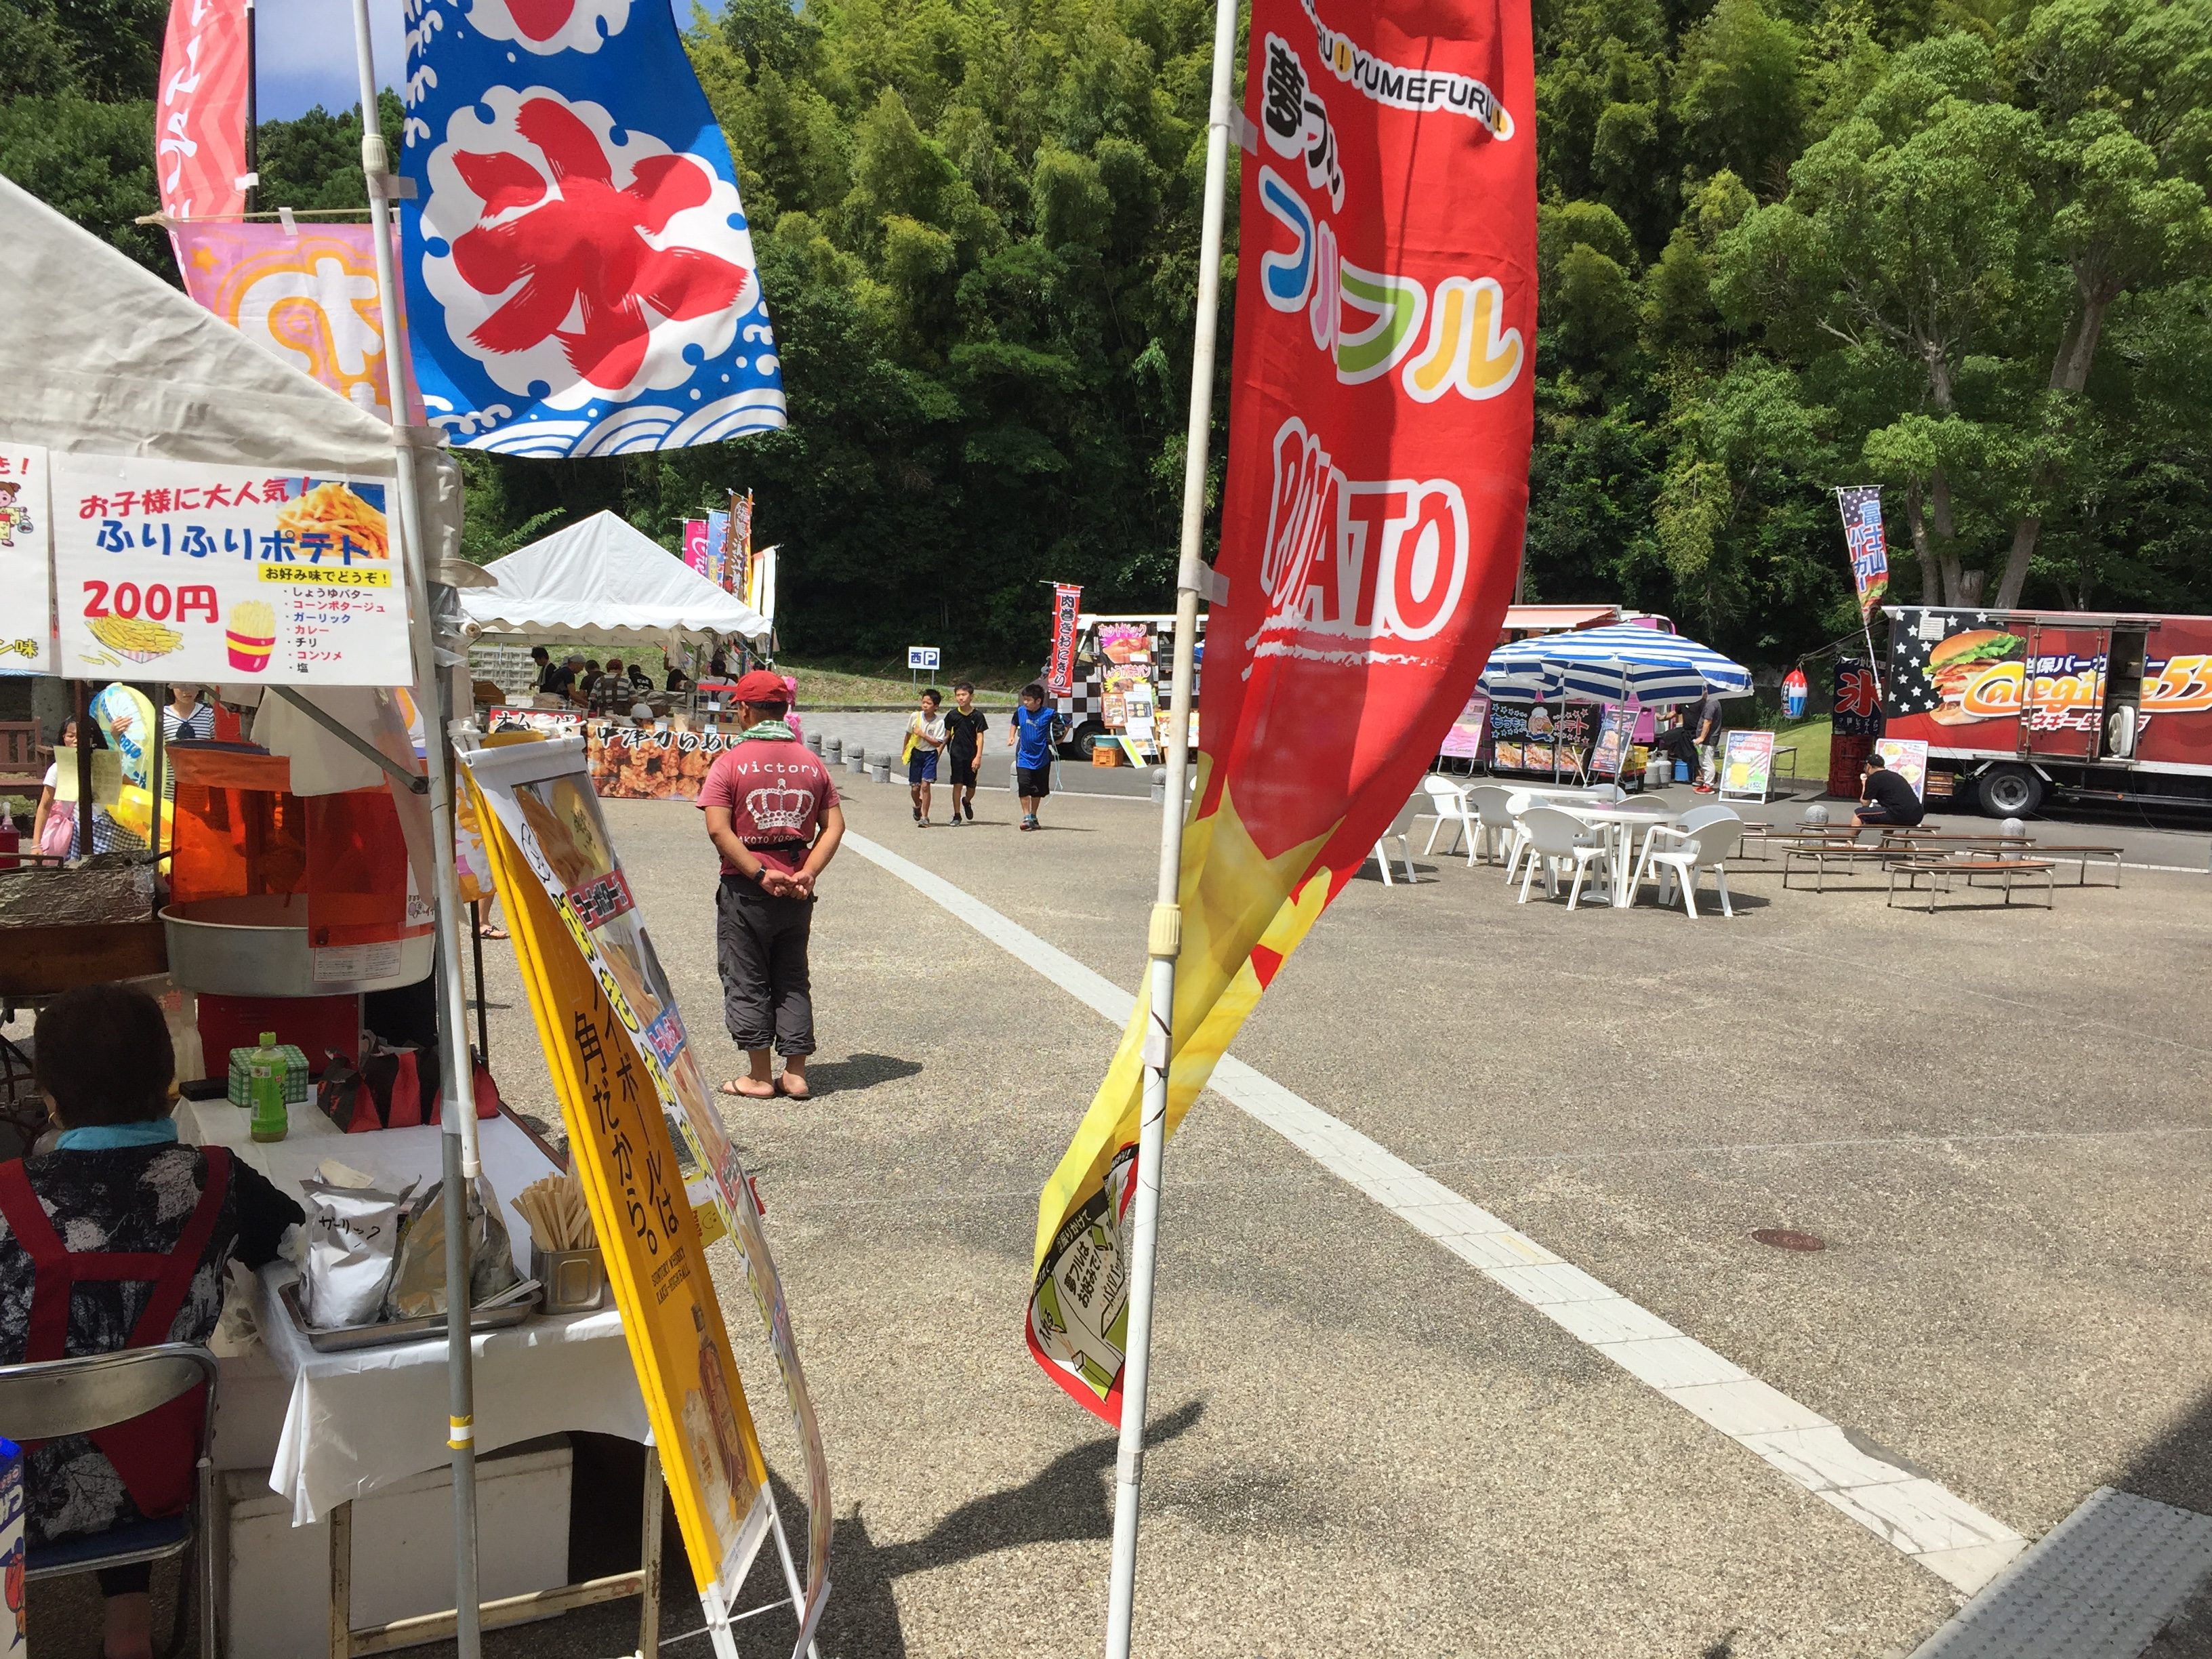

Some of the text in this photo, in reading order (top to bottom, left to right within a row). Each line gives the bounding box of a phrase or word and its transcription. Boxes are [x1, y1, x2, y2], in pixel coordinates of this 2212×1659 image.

[79, 476, 310, 520] お子様に大人気！
[96, 519, 370, 565] ふりふりポテト
[1860, 500, 1888, 575] 富士山
[266, 567, 387, 584] お好み味でどうぞ！
[293, 587, 373, 599] しょうゆバター
[83, 580, 220, 623] 200円
[294, 600, 386, 613] コーンポタージュ
[294, 612, 351, 623] ガーリック
[295, 625, 329, 635] カレー
[295, 638, 317, 647] チリ
[298, 651, 342, 661] コンソメ
[925, 652, 937, 665] P
[298, 663, 308, 673] 塩
[1835, 669, 1882, 717] 氷
[497, 711, 575, 733] オムば
[575, 1012, 656, 1254] 角だから。
